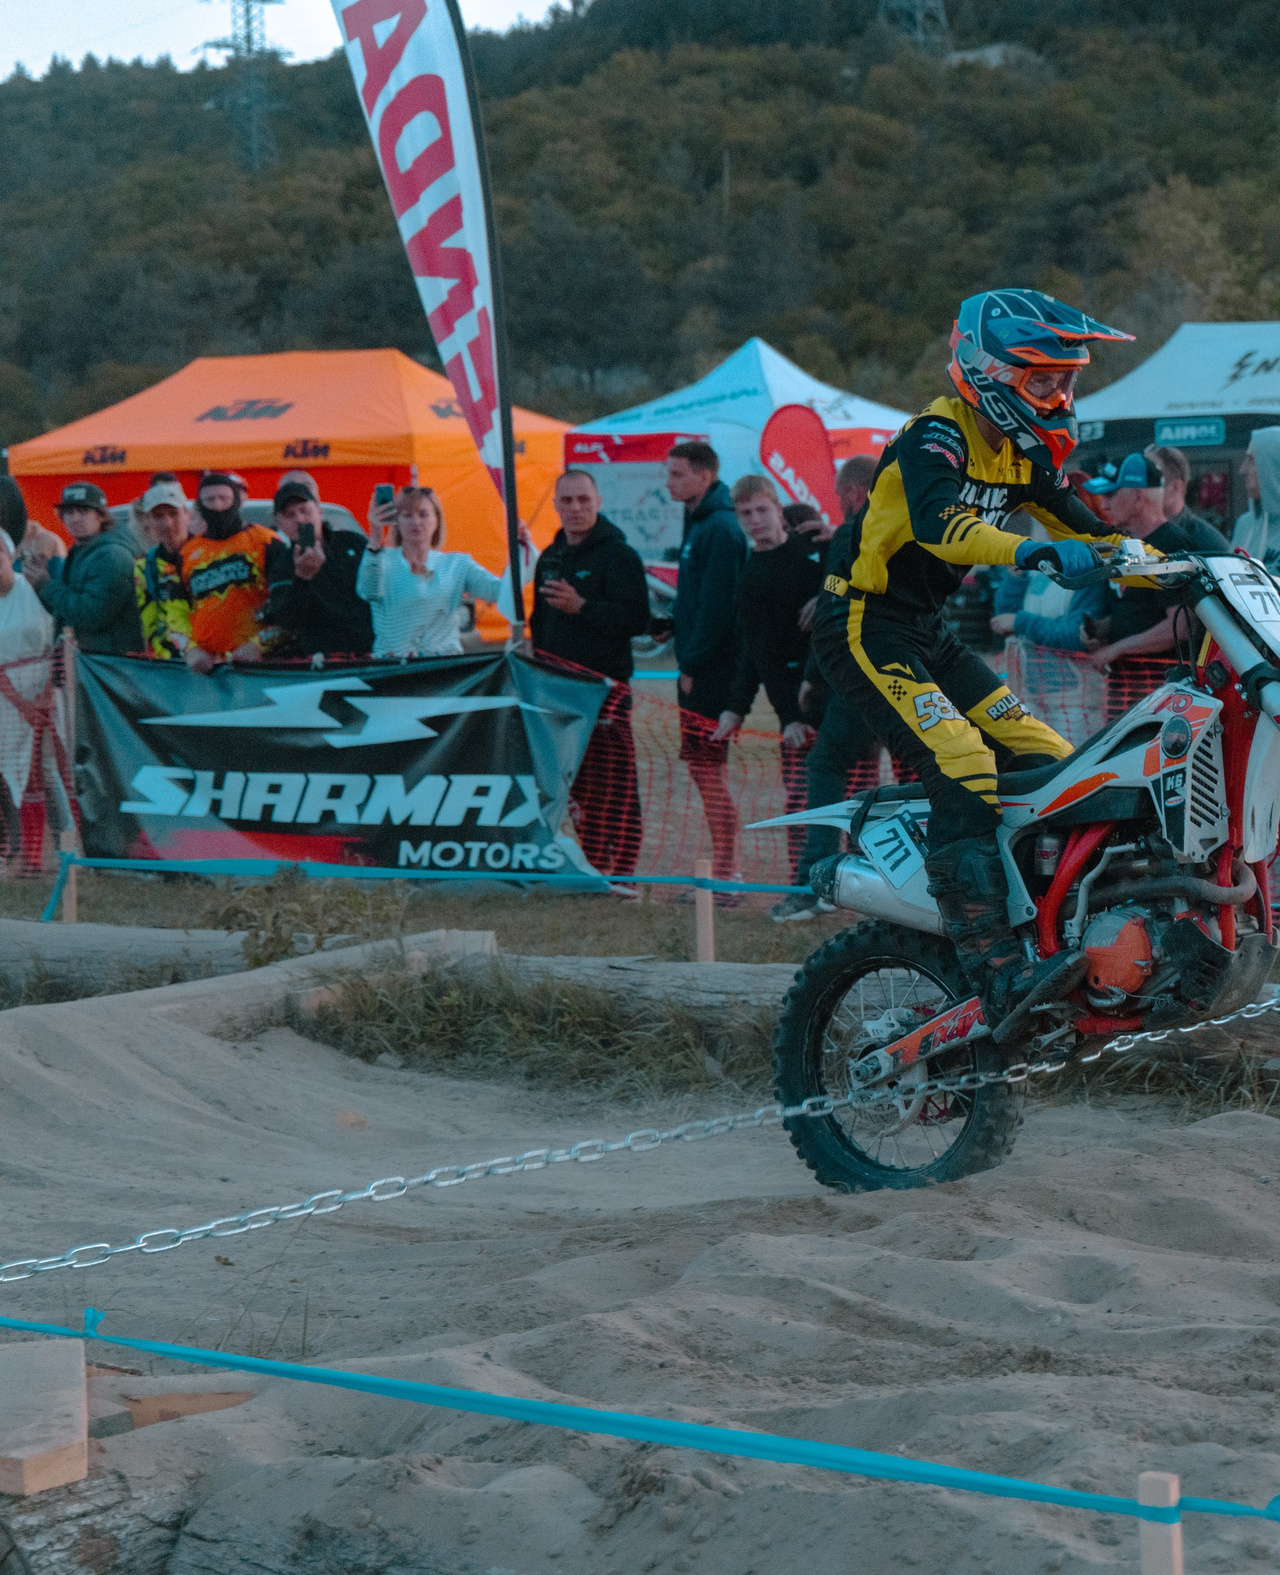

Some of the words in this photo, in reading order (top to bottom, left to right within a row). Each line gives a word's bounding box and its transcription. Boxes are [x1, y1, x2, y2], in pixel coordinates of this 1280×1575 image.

[956, 338, 1013, 382] 100%
[195, 399, 295, 422] KTM
[83, 446, 127, 466] KTM
[283, 439, 330, 460] KTM
[914, 691, 966, 731] 58
[120, 765, 548, 827] SHARMAX
[398, 840, 566, 870] MOTORS
[873, 827, 911, 872] 711
